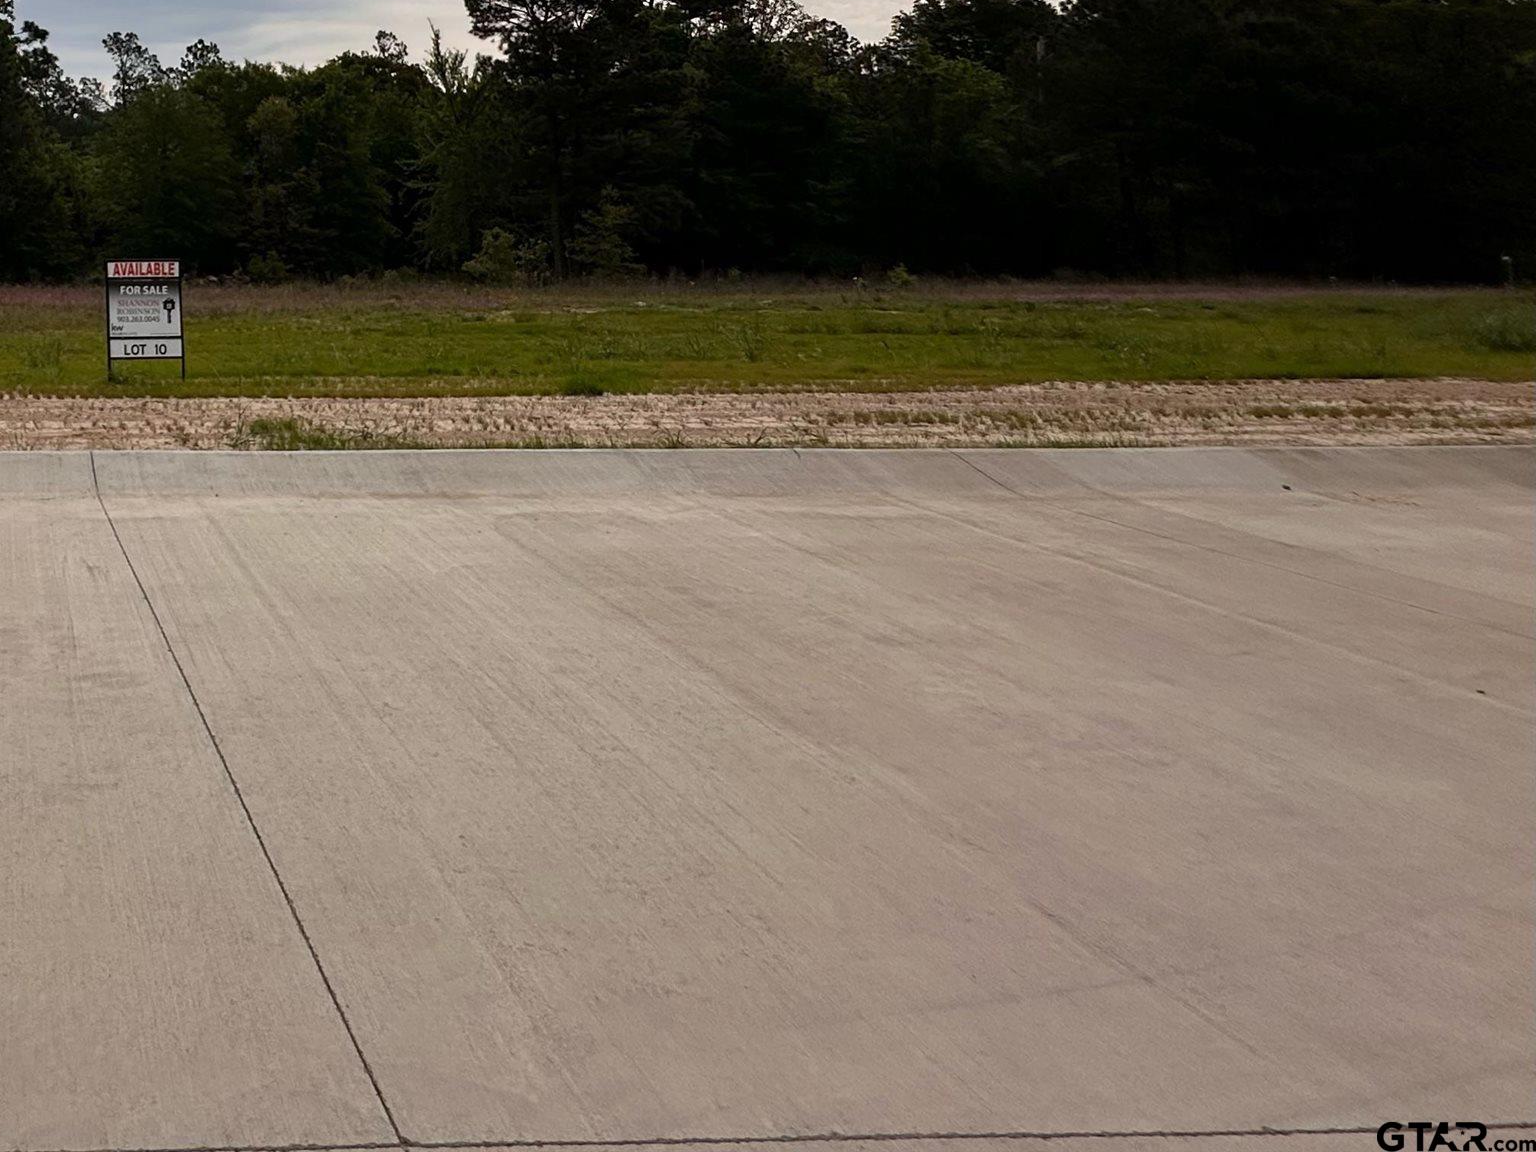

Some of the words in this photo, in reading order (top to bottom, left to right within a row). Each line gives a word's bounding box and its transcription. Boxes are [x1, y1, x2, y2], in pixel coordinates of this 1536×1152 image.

[113, 262, 175, 276] AVAILABLE
[120, 286, 141, 295] FOR
[143, 285, 168, 295] SALE
[123, 344, 146, 356] LOT
[155, 344, 167, 355] 10
